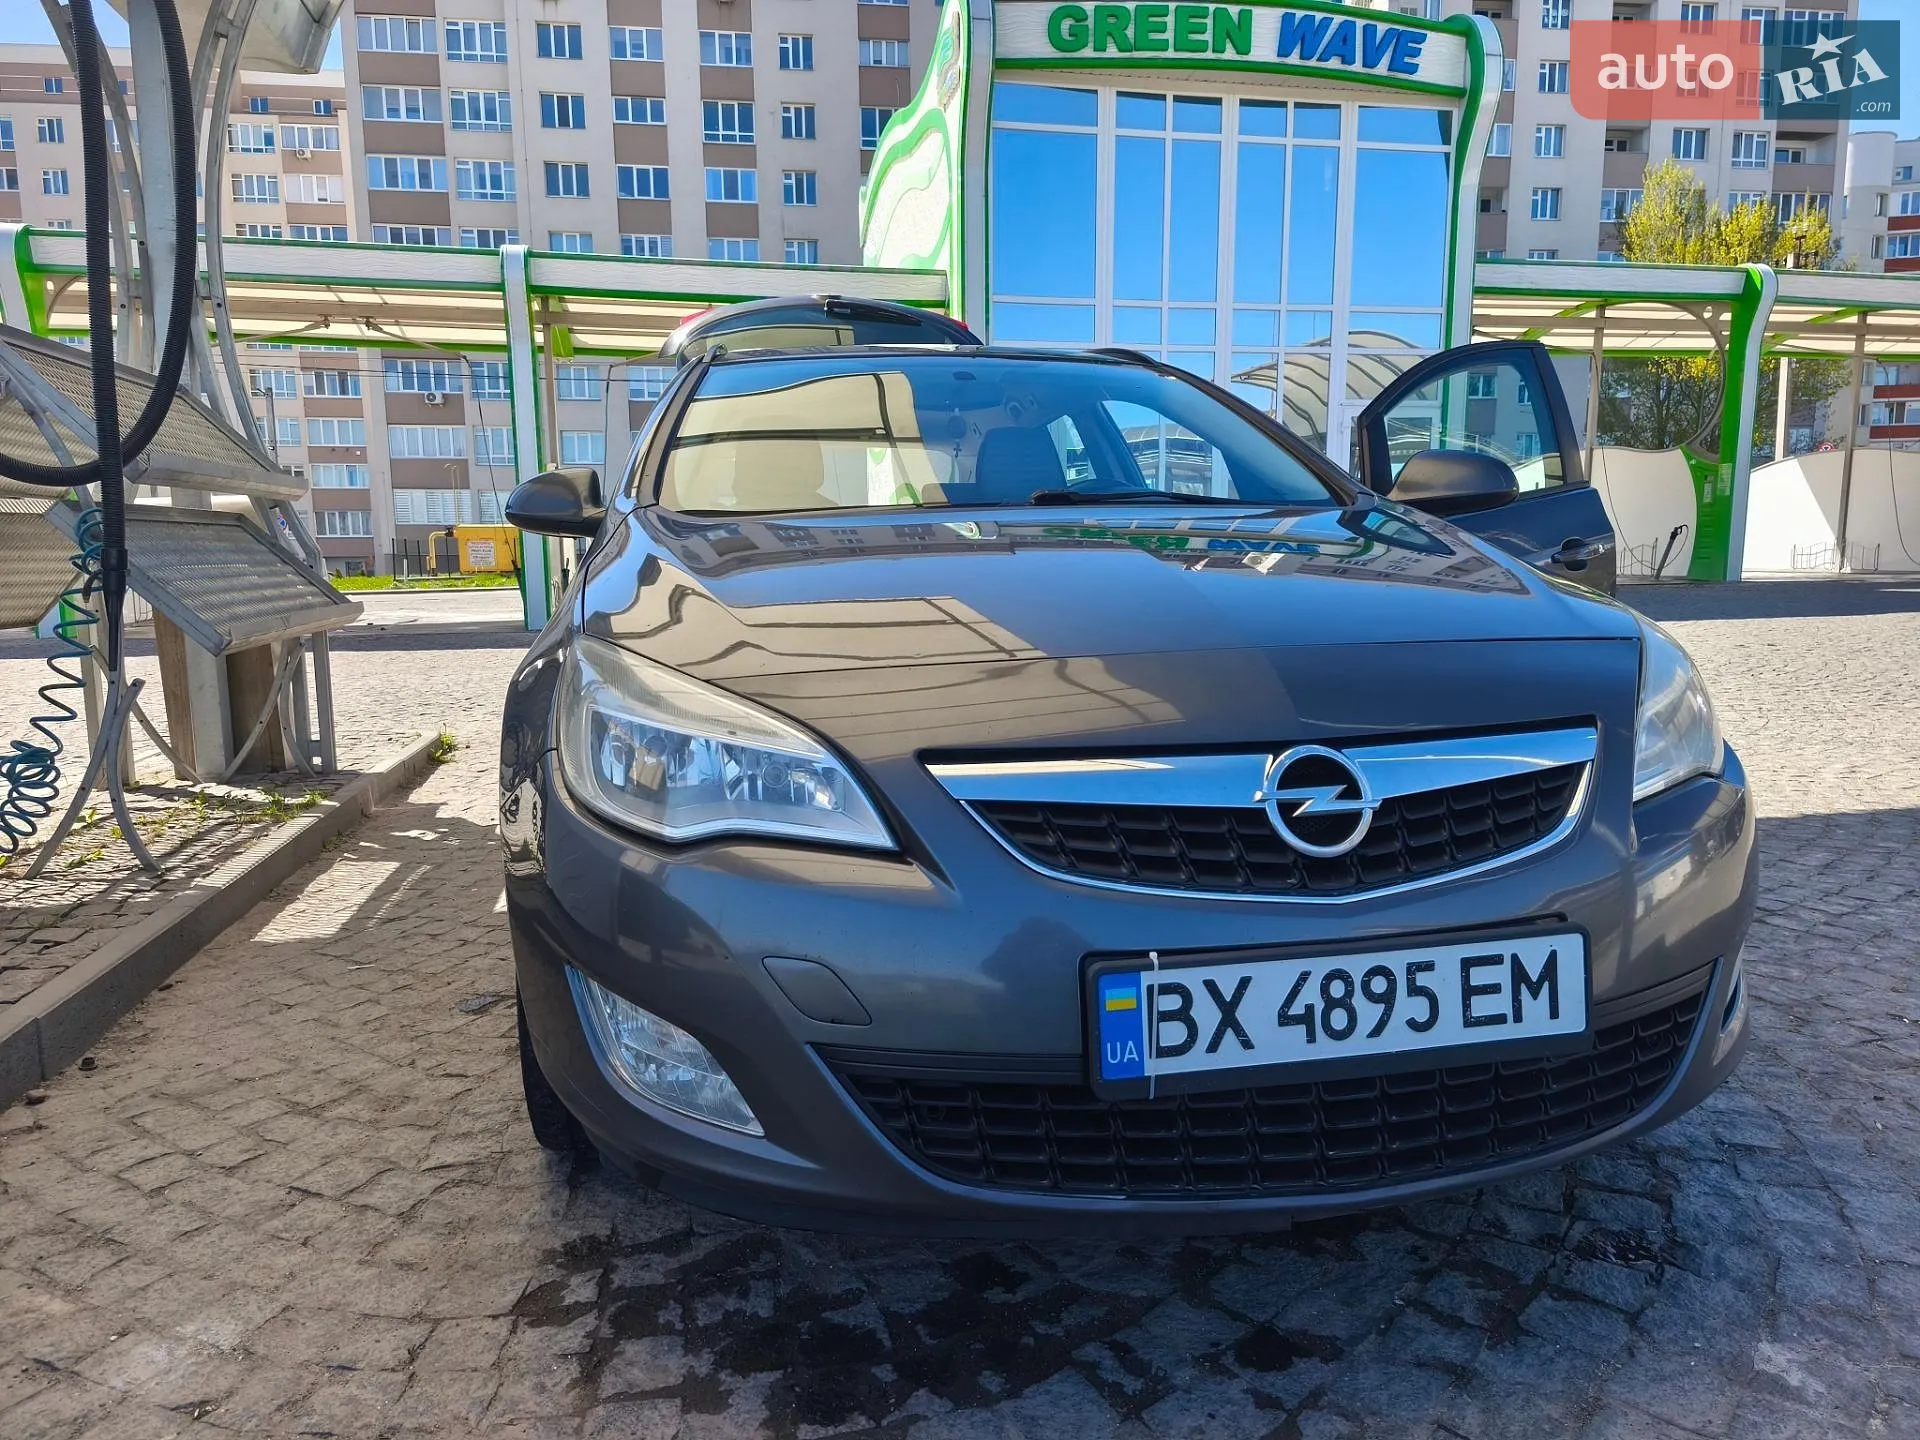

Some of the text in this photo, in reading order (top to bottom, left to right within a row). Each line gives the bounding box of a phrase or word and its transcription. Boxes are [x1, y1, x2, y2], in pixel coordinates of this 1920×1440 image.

[1047, 4, 1428, 75] GREEN WAVE
[1146, 949, 1559, 1060] BX 4895 EM
[1107, 1040, 1139, 1064] UA
